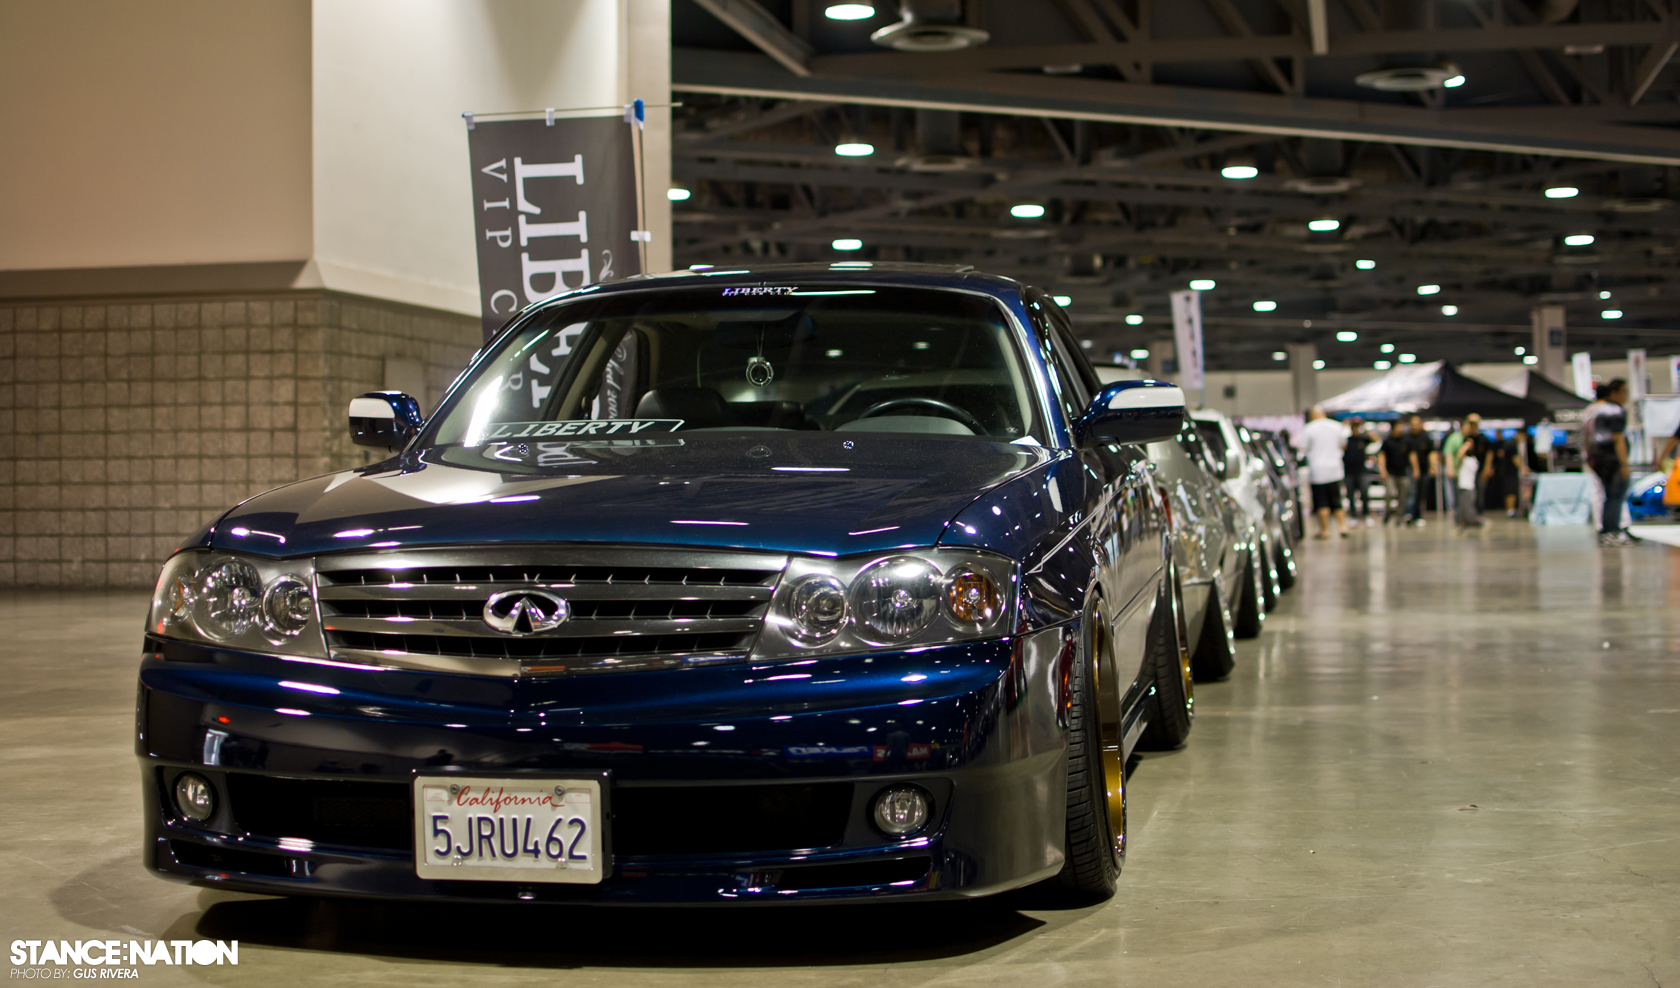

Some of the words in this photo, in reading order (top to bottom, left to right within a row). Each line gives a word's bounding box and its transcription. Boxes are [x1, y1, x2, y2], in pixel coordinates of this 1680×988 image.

[481, 158, 513, 249] VIP
[722, 286, 799, 297] LIBERTY
[489, 421, 655, 438] LIBERTY
[456, 785, 565, 813] California
[432, 815, 588, 861] 5JRU462
